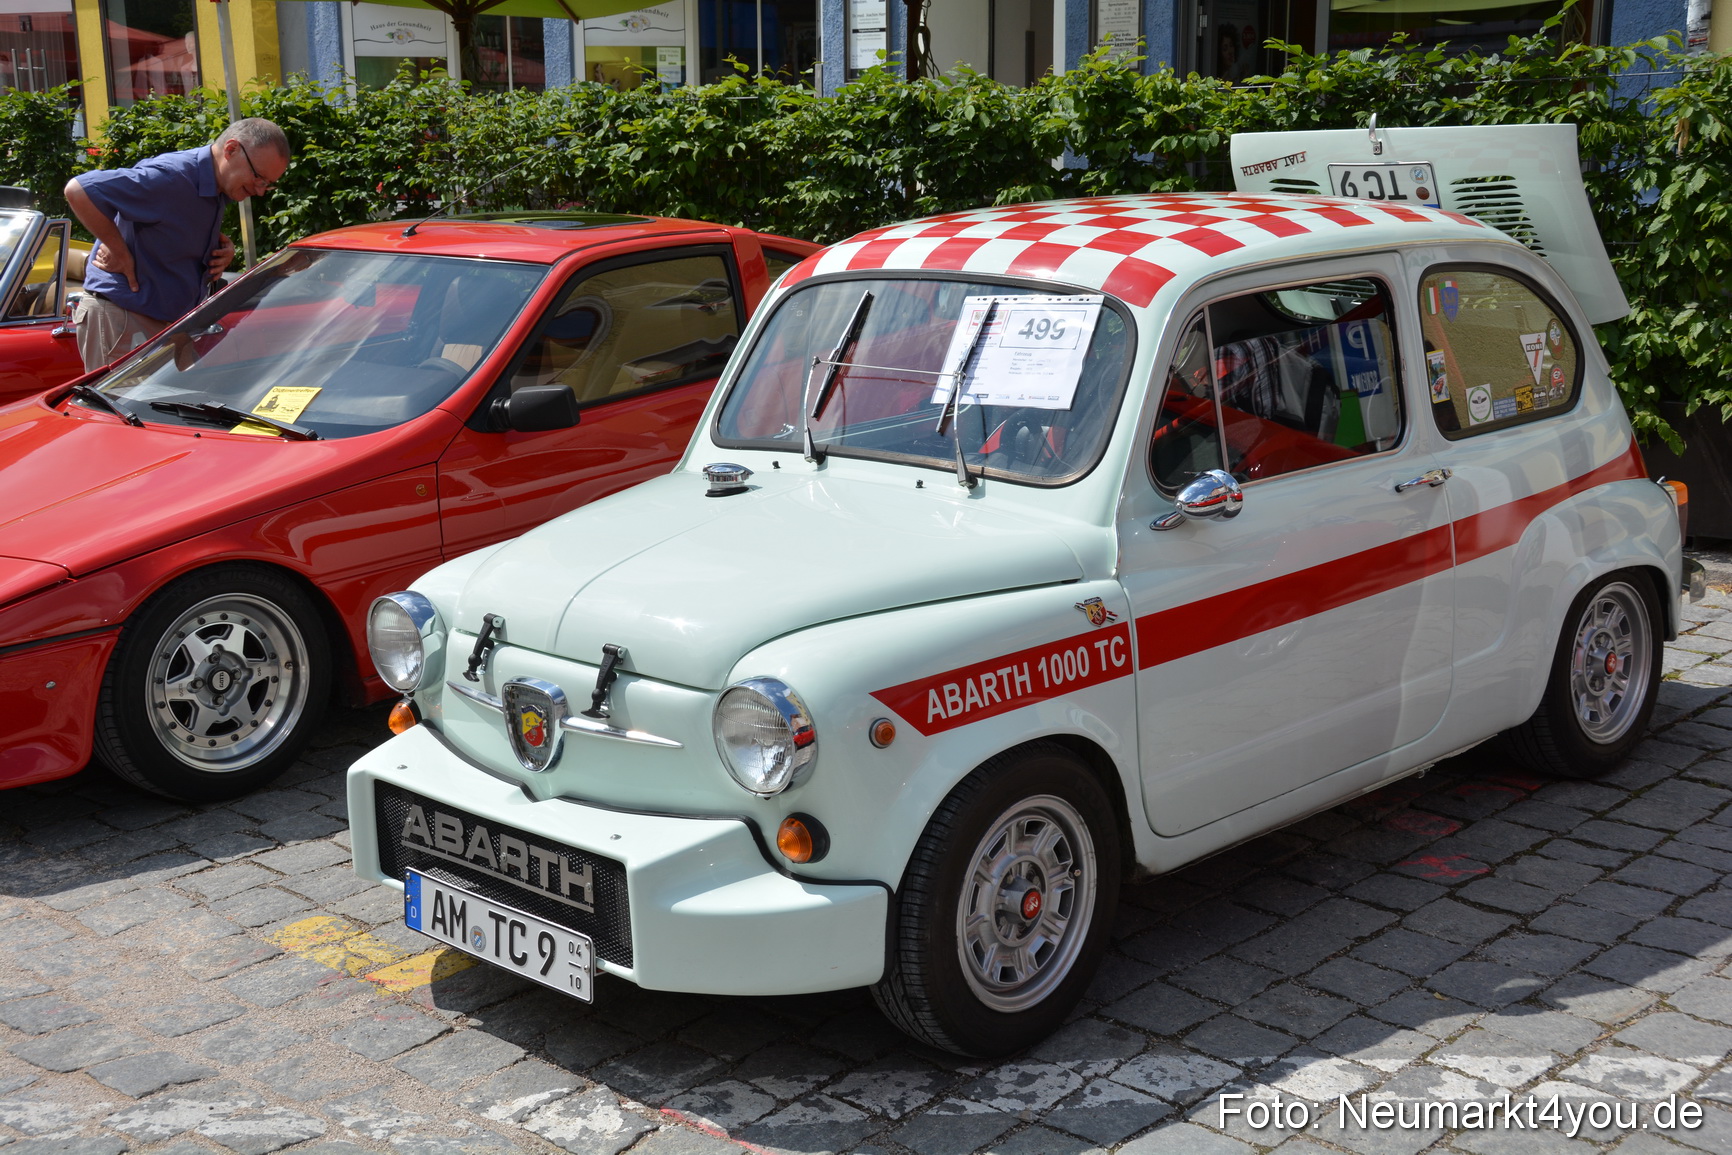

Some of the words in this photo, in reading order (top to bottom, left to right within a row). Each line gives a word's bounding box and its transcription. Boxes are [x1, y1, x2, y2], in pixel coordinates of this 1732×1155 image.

[370, 23, 386, 31] Haus
[398, 21, 432, 32] Gesundheit
[1240, 158, 1278, 177] ABARTH
[1284, 151, 1307, 168] FIAT
[1363, 170, 1408, 200] TC
[1017, 318, 1066, 341] 499
[1526, 343, 1543, 351] KONI
[927, 662, 1032, 723] ABARTH
[1037, 646, 1090, 688] 1000
[1094, 635, 1127, 672] TC
[401, 803, 594, 904] ABARTH
[410, 905, 417, 919] D
[431, 889, 467, 944] AM
[488, 910, 528, 967] TC
[537, 930, 556, 977] 9
[568, 940, 582, 957] 04
[569, 974, 582, 990] 10
